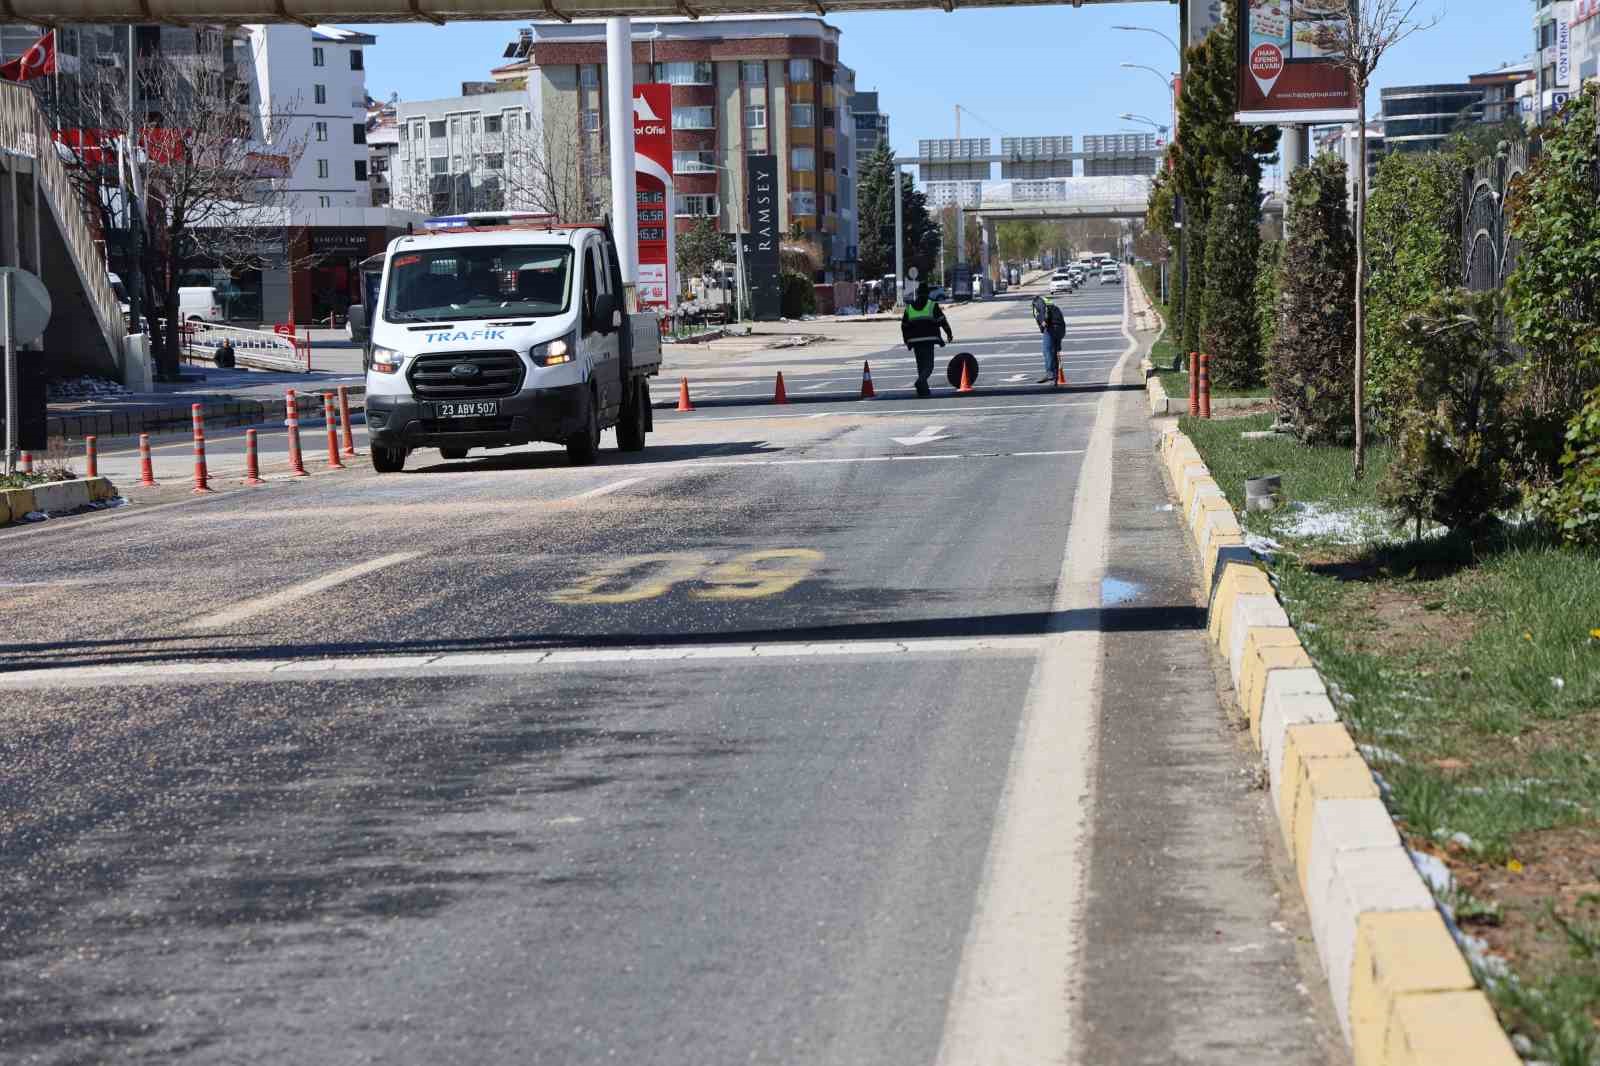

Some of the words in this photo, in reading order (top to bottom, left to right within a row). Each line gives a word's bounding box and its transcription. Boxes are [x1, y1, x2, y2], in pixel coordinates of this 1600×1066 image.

[757, 170, 771, 250] RAMSEY
[442, 404, 454, 415] 23
[458, 403, 475, 414] ABV
[477, 402, 494, 413] 507
